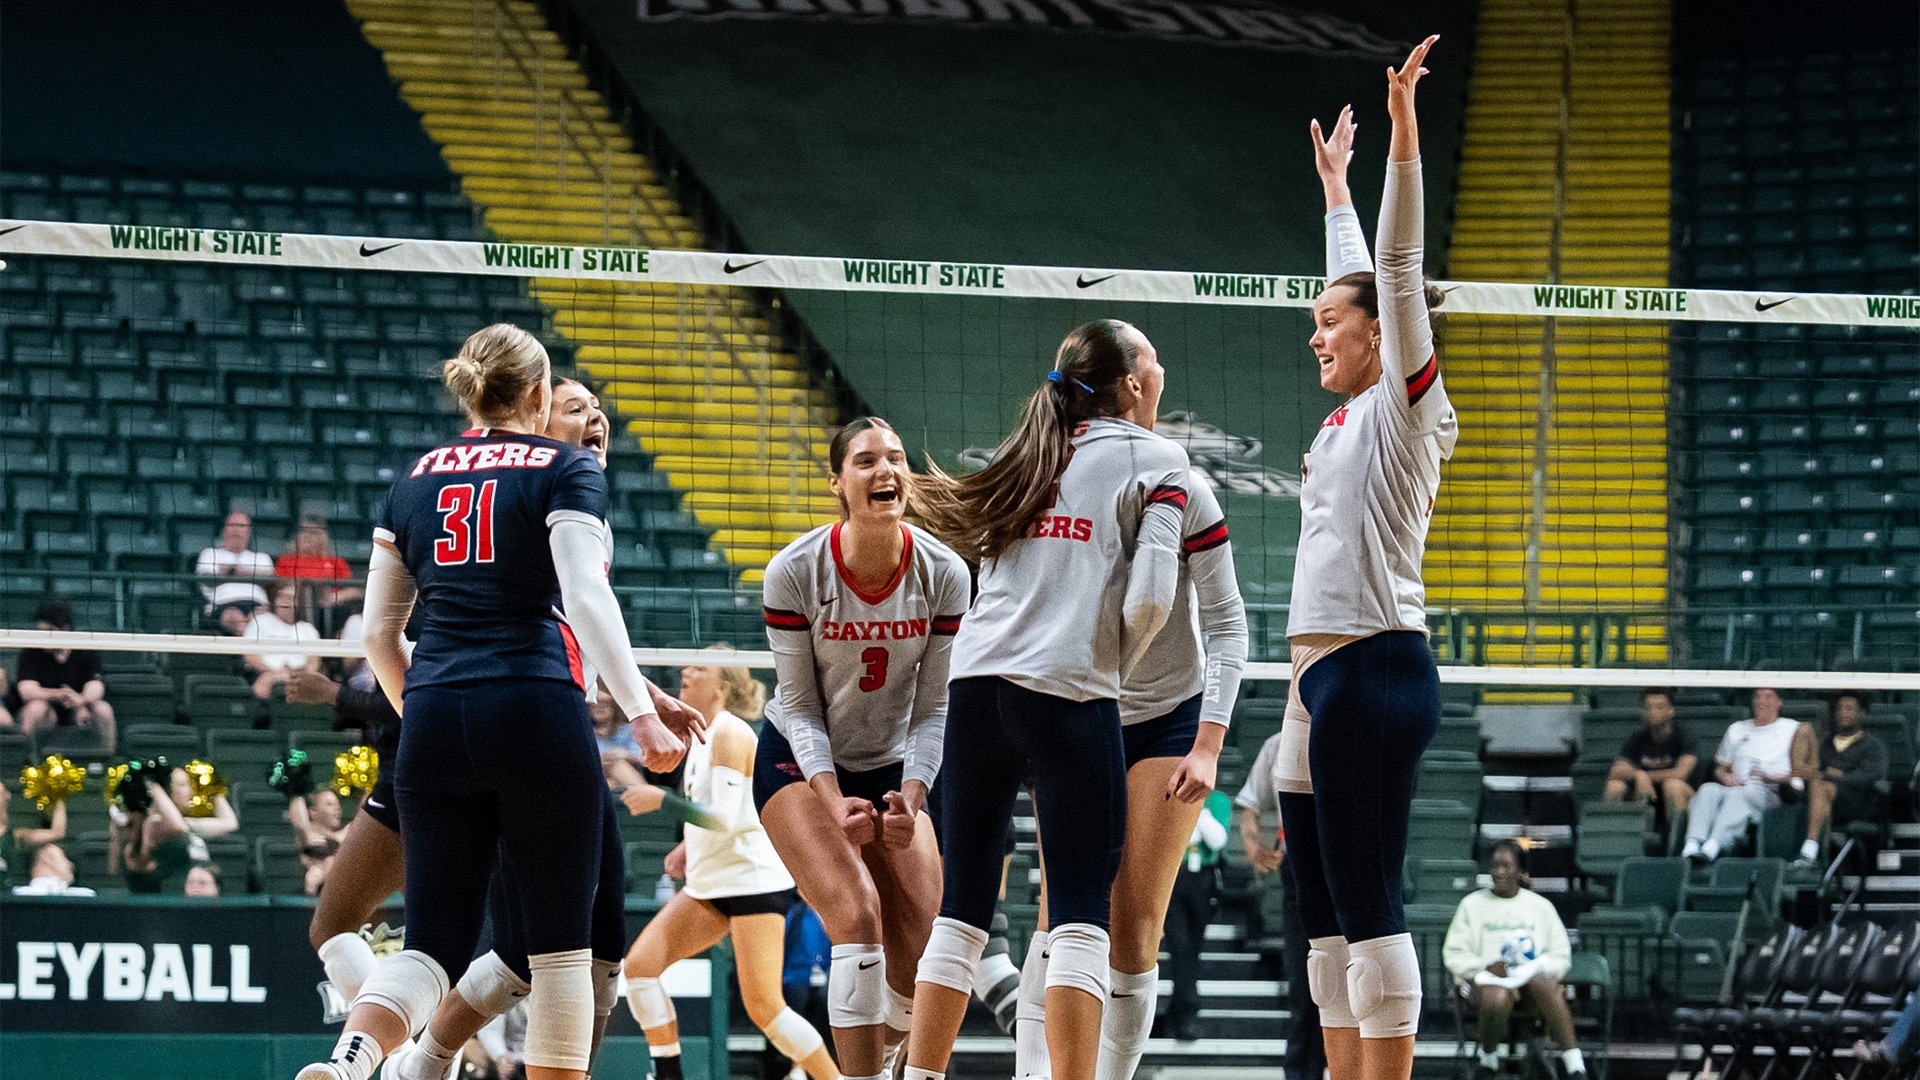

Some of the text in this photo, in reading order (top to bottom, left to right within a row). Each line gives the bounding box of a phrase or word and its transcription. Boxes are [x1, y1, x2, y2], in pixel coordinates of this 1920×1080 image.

[110, 225, 283, 256] WRIGHT STATE
[484, 243, 650, 274] WRIGHT STATE
[844, 260, 1005, 289] WRIGHT STATE
[1193, 274, 1328, 300] WRIGHT STA
[1534, 286, 1688, 312] WRIGHT STATE
[1867, 296, 1920, 319] WRIG
[410, 442, 558, 479] FLYERS
[434, 479, 498, 567] 31
[1031, 515, 1093, 543] ERS
[822, 618, 928, 641] DAYTON
[859, 646, 889, 693] 3
[1204, 651, 1222, 704] LEGACY
